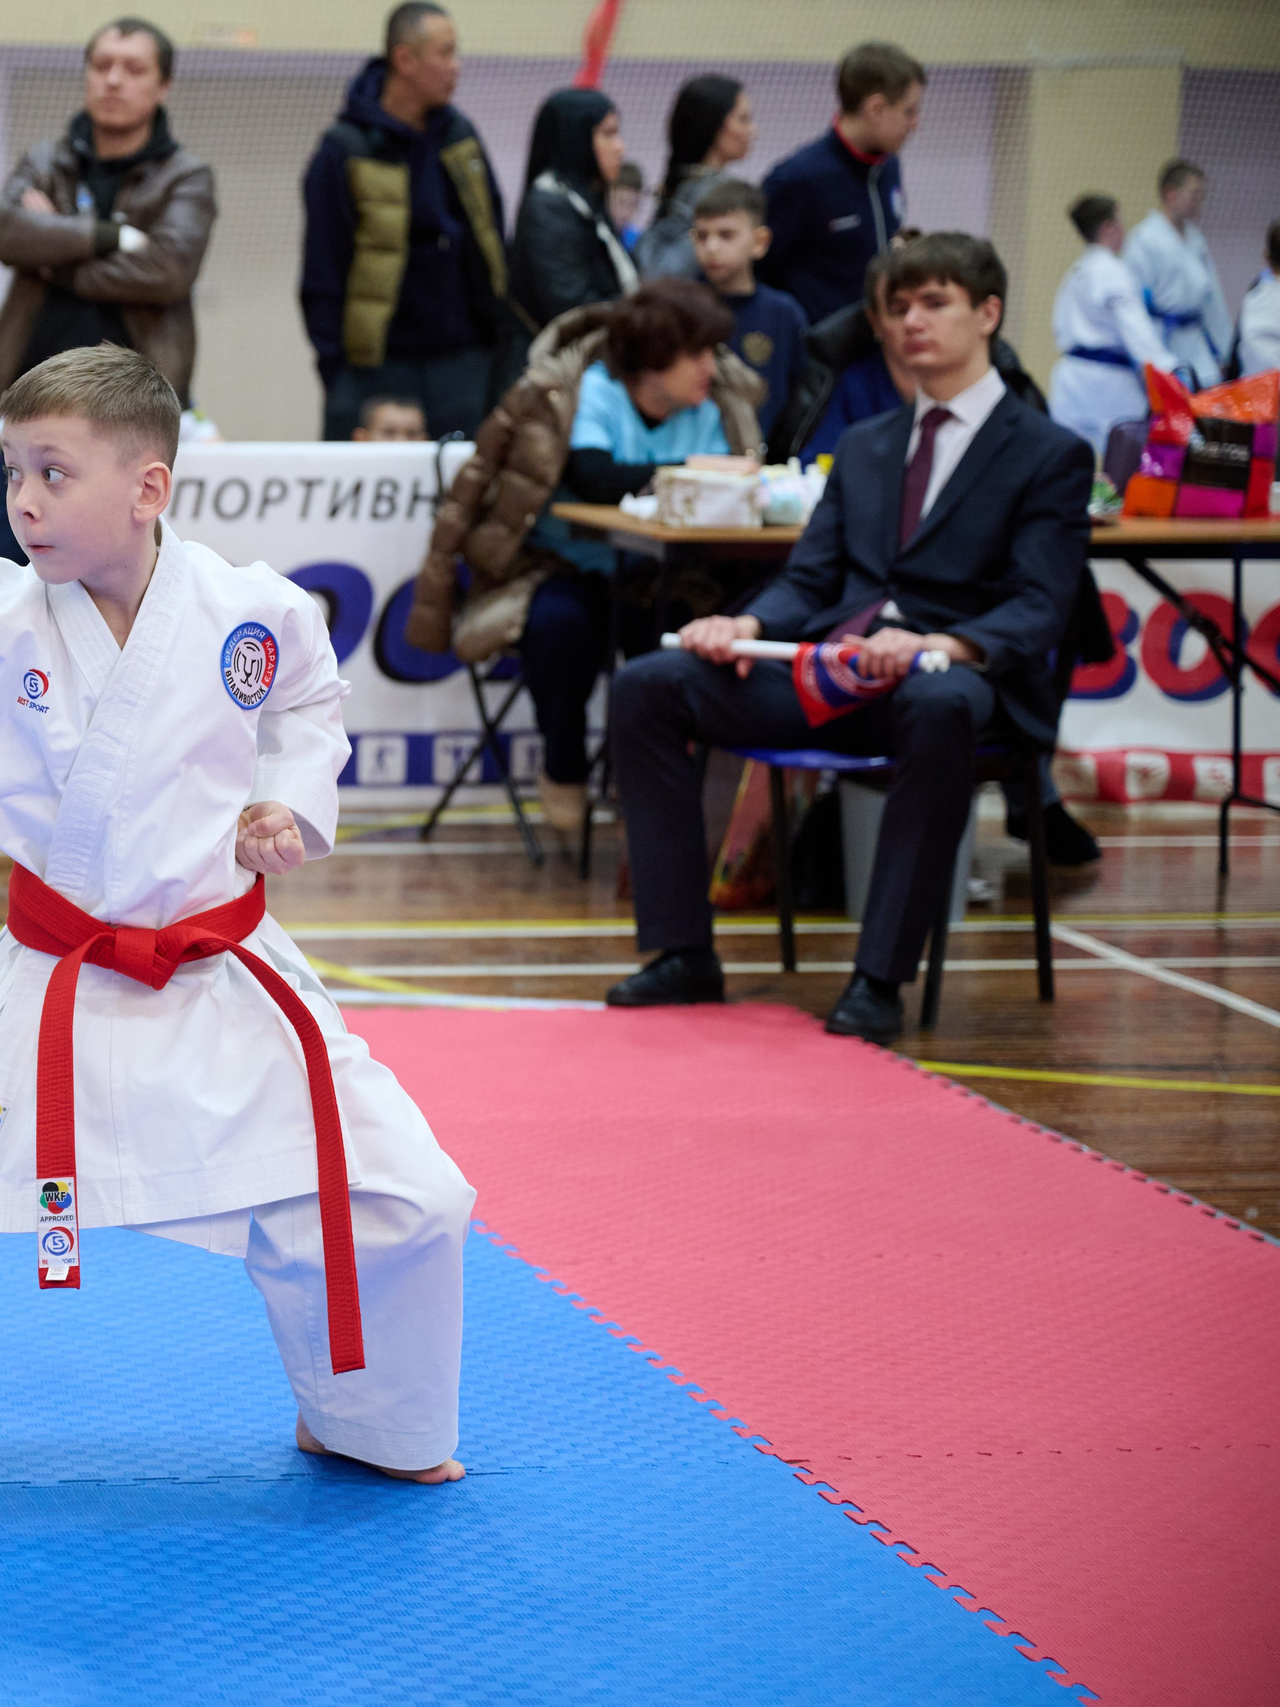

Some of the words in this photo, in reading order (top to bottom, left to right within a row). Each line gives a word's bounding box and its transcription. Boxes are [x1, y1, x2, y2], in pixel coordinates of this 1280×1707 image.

[225, 627, 266, 664] ФЕДЕРАЦИЯ
[264, 640, 276, 683] КАРАТЭ
[225, 669, 266, 705] ВЛАДИВОСТОК
[17, 696, 29, 707] BEST
[29, 701, 50, 714] SPORT
[45, 1191, 66, 1202] WKF
[40, 1214, 74, 1222] APPROVED
